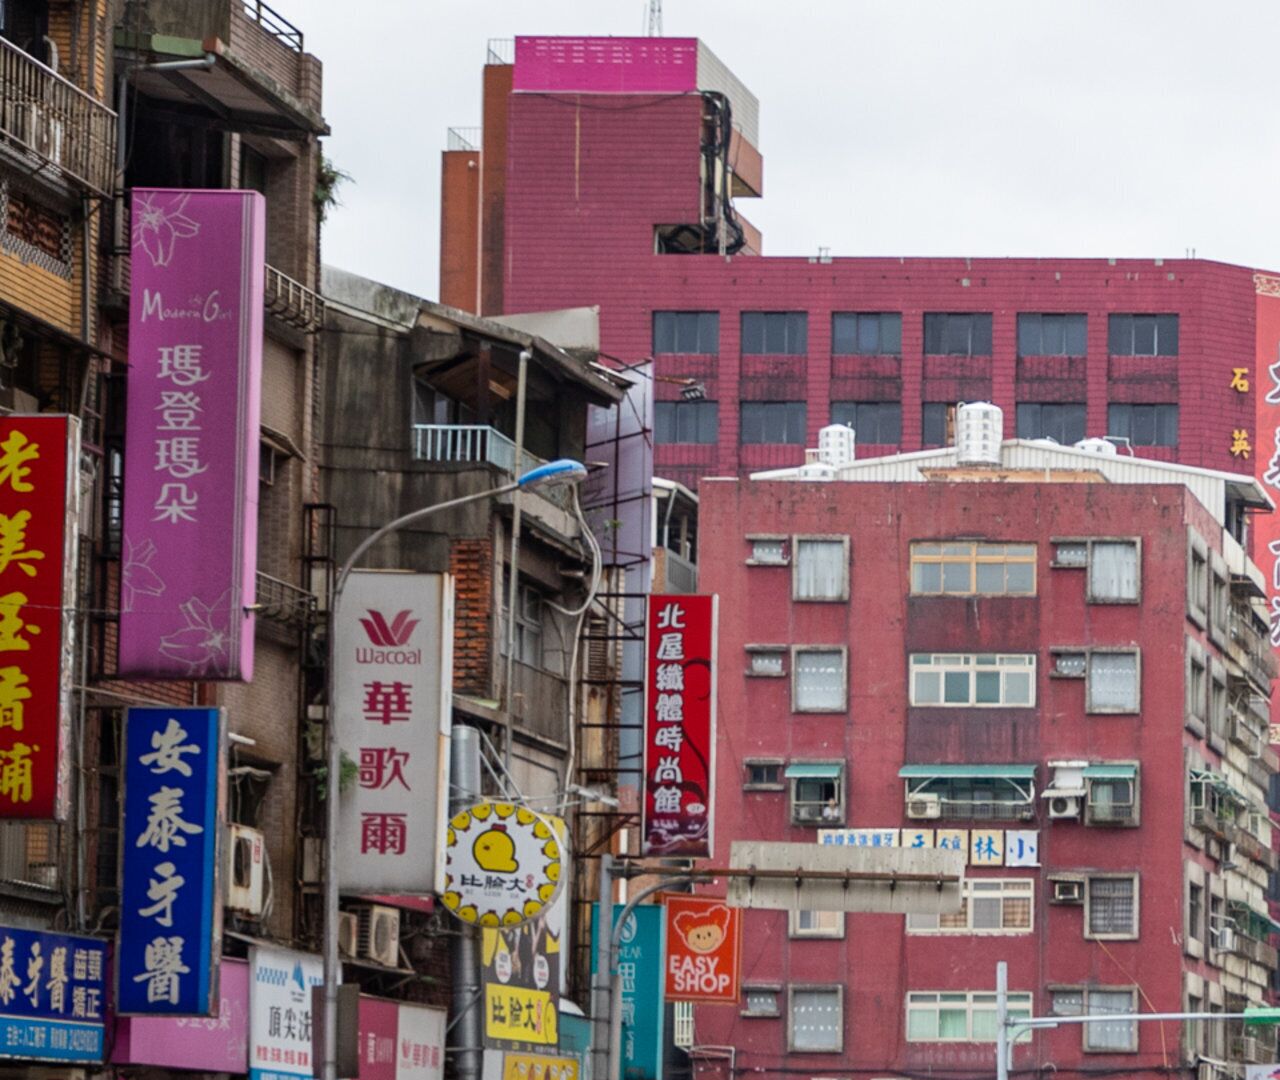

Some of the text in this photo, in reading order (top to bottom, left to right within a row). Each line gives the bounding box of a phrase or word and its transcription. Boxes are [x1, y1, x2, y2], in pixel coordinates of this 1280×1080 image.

[152, 345, 211, 524] 瑪登瑪朵
[355, 647, 421, 665] Wacoal
[653, 603, 687, 814] 北屋纖體時尚館
[358, 681, 413, 856] 華歌爾
[136, 718, 204, 1005] 安泰牙醫
[670, 955, 719, 978] EASY
[674, 972, 730, 993] SHOP
